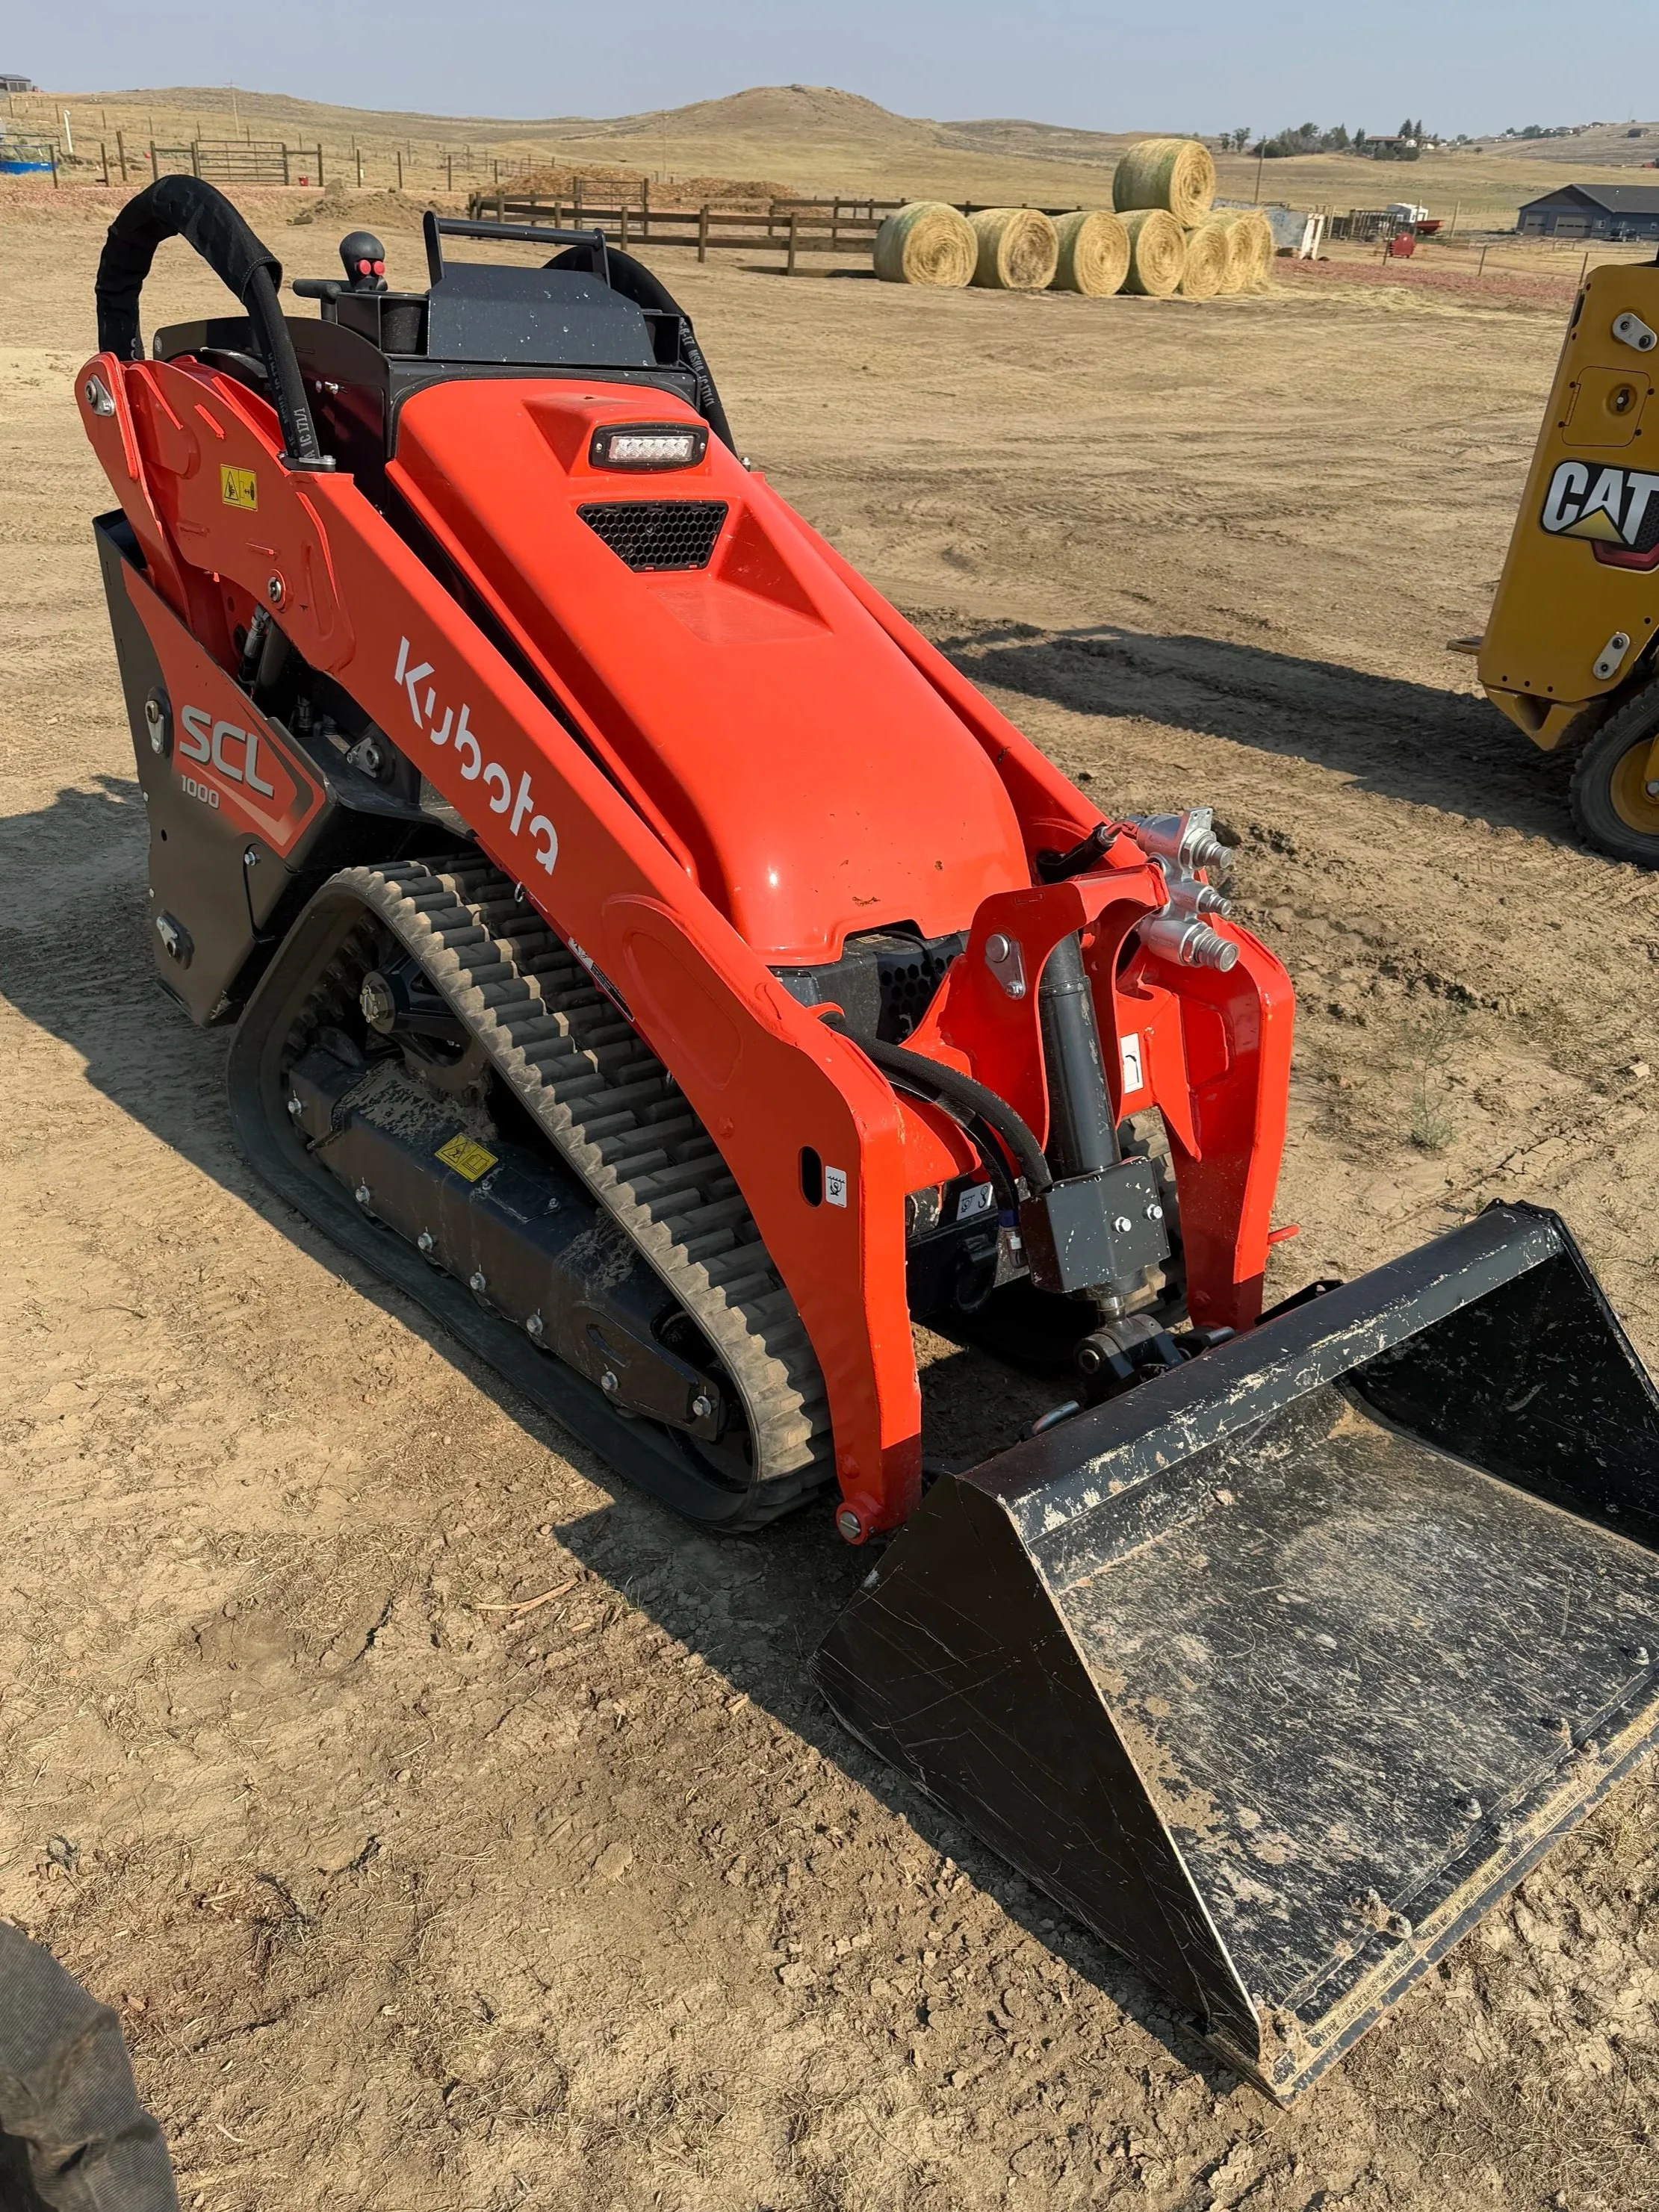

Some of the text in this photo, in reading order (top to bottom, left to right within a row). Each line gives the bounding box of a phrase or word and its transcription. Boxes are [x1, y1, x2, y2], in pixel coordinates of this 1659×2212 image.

[294, 407, 309, 433] 171/1
[1542, 462, 1659, 545] CAT
[179, 705, 274, 798] SCL
[182, 774, 220, 809] 1000
[394, 636, 558, 875] Kubota
